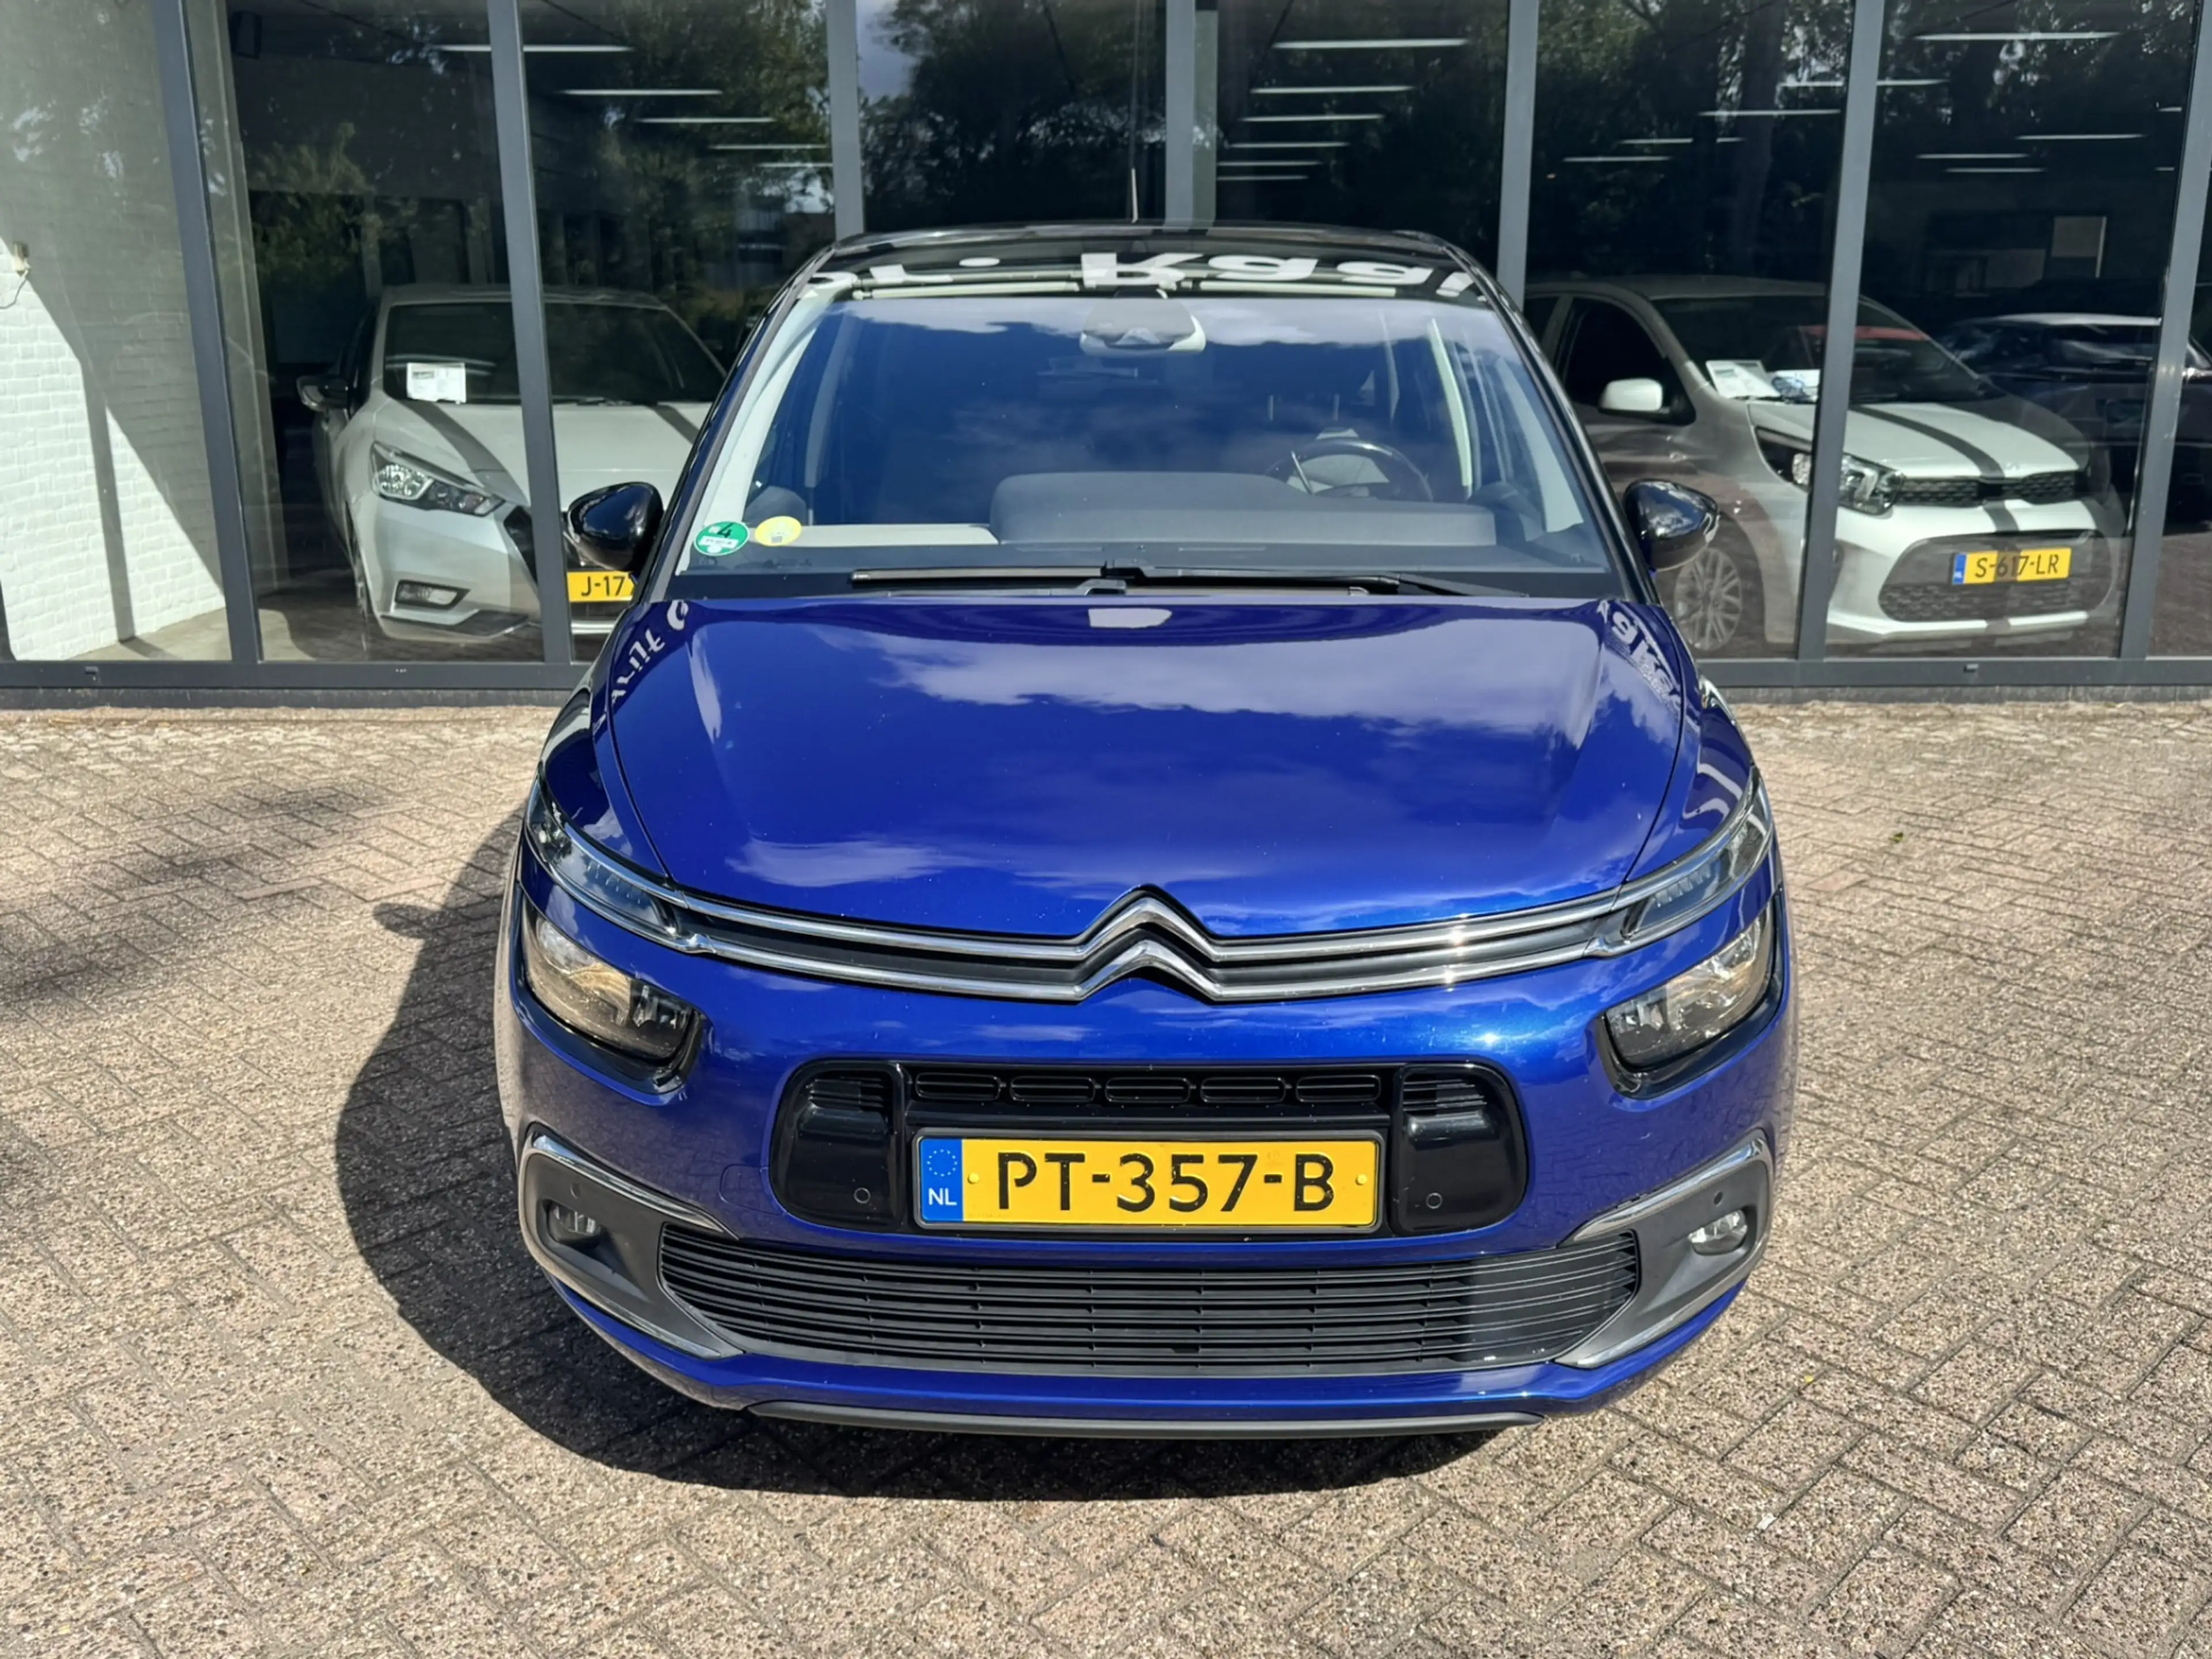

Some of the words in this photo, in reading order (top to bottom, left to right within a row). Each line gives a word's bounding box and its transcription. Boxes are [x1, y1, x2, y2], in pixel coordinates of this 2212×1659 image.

[717, 523, 733, 538] 4
[1975, 554, 2059, 578] S-617-LR
[581, 576, 634, 597] J-17
[998, 1152, 1334, 1213] PT-357-B
[929, 1188, 957, 1206] NL
